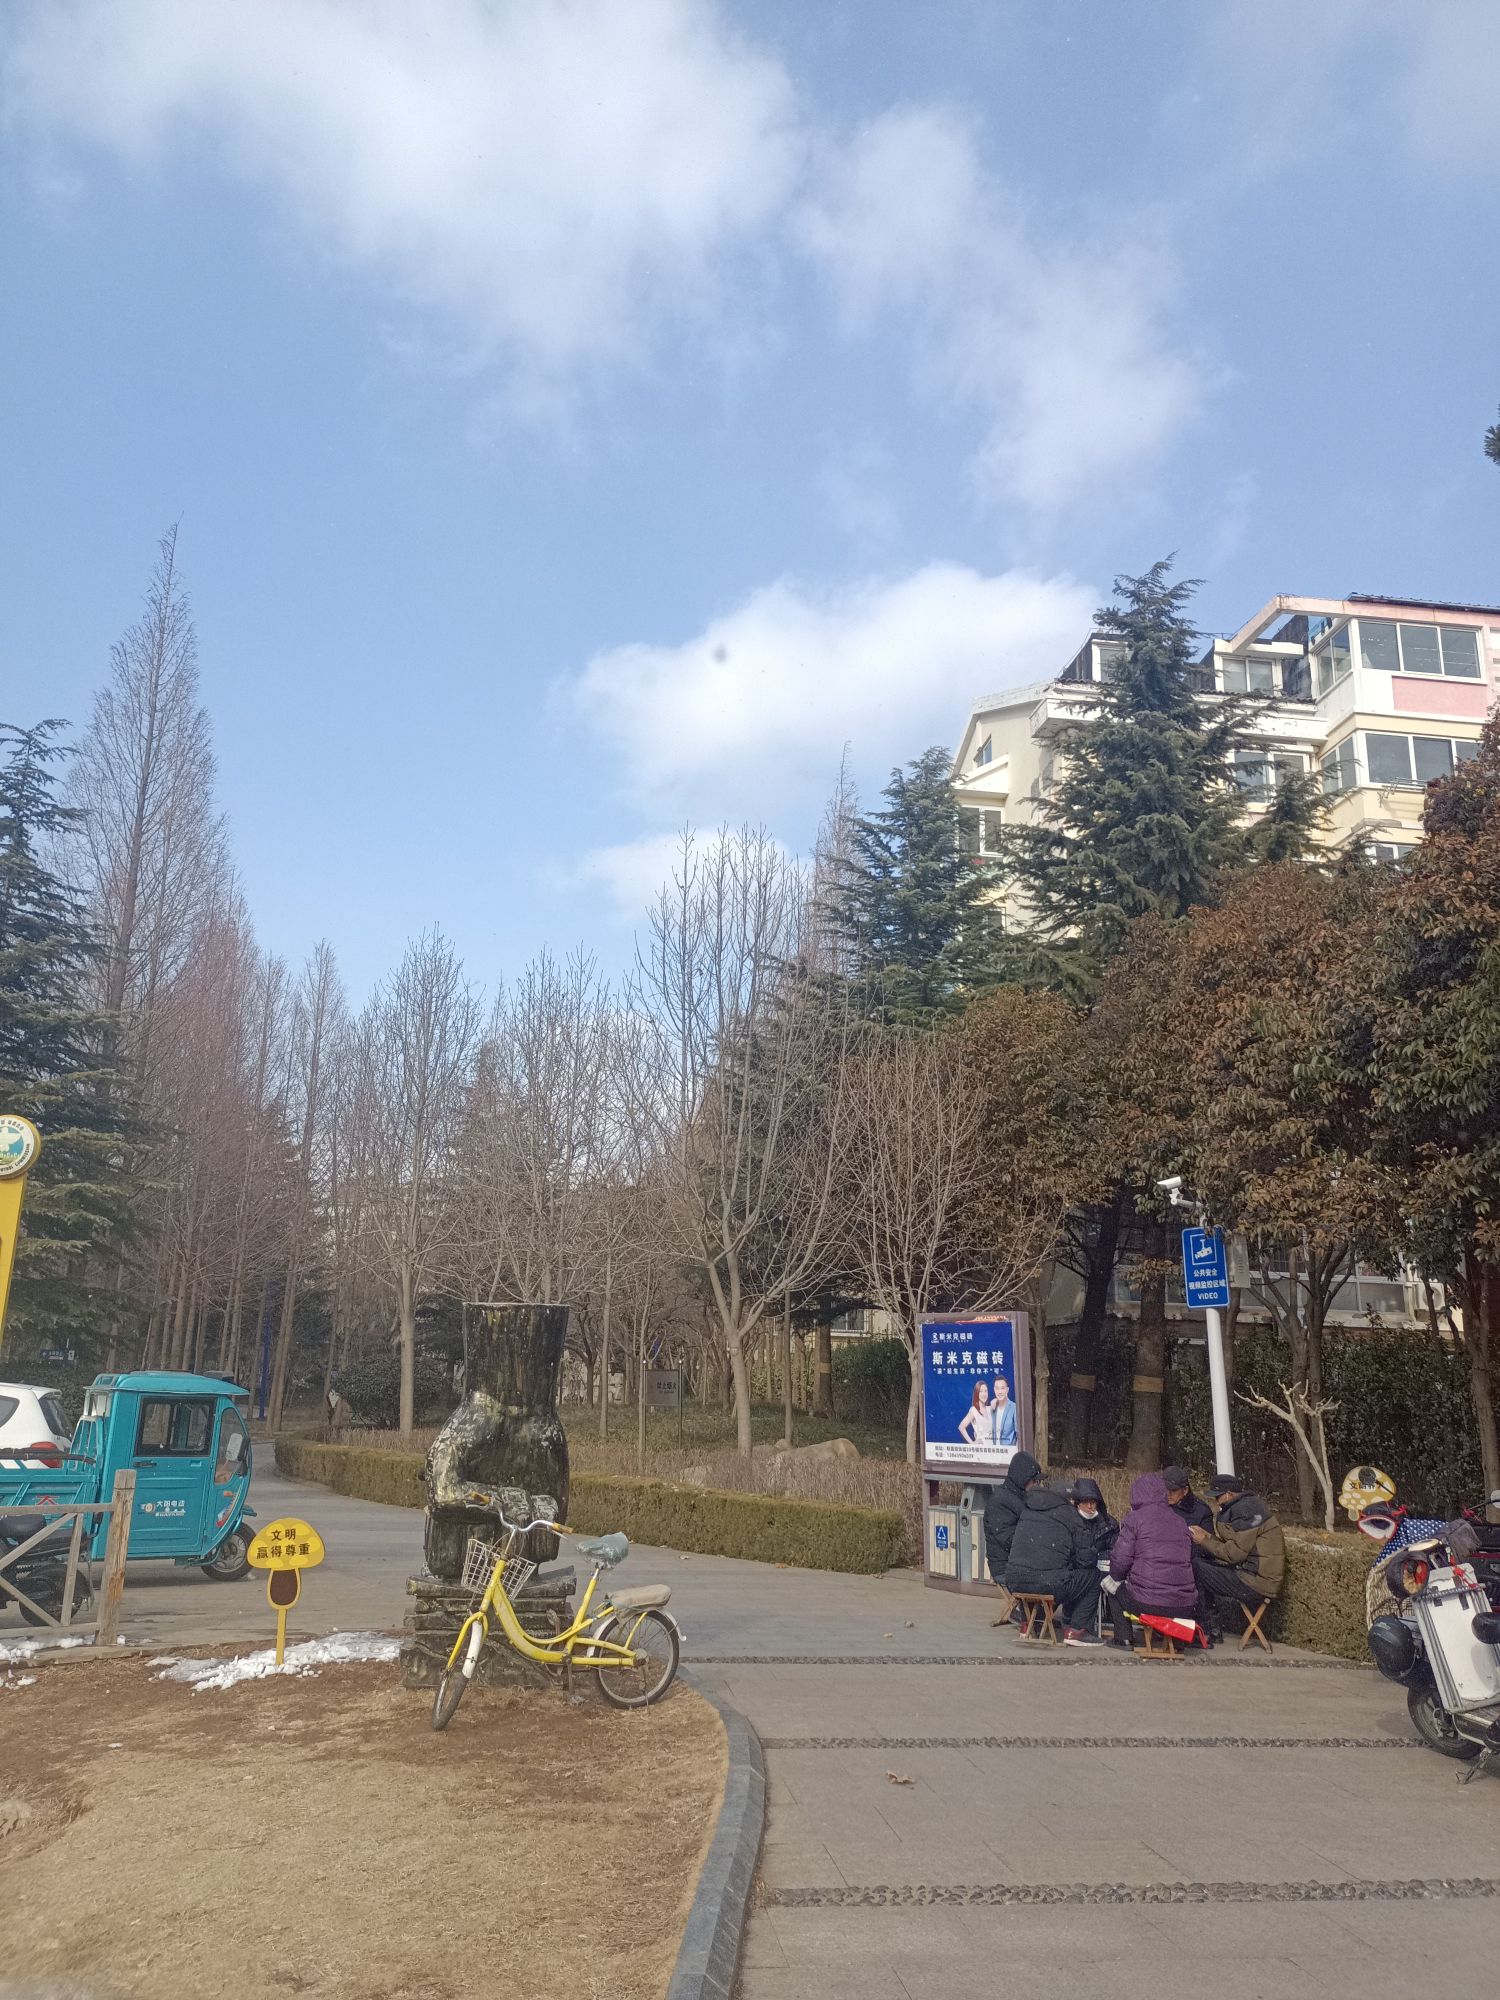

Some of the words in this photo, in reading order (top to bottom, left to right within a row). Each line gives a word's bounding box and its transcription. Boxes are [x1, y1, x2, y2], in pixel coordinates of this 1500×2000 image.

[1193, 1268, 1218, 1277] 公共安全
[1188, 1279, 1227, 1290] 视频监控区域
[1197, 1292, 1219, 1300] VIDEO
[932, 1350, 1004, 1365] 斯米克磁砖
[271, 1528, 297, 1541] 文明
[256, 1542, 310, 1559] 赢得尊重
